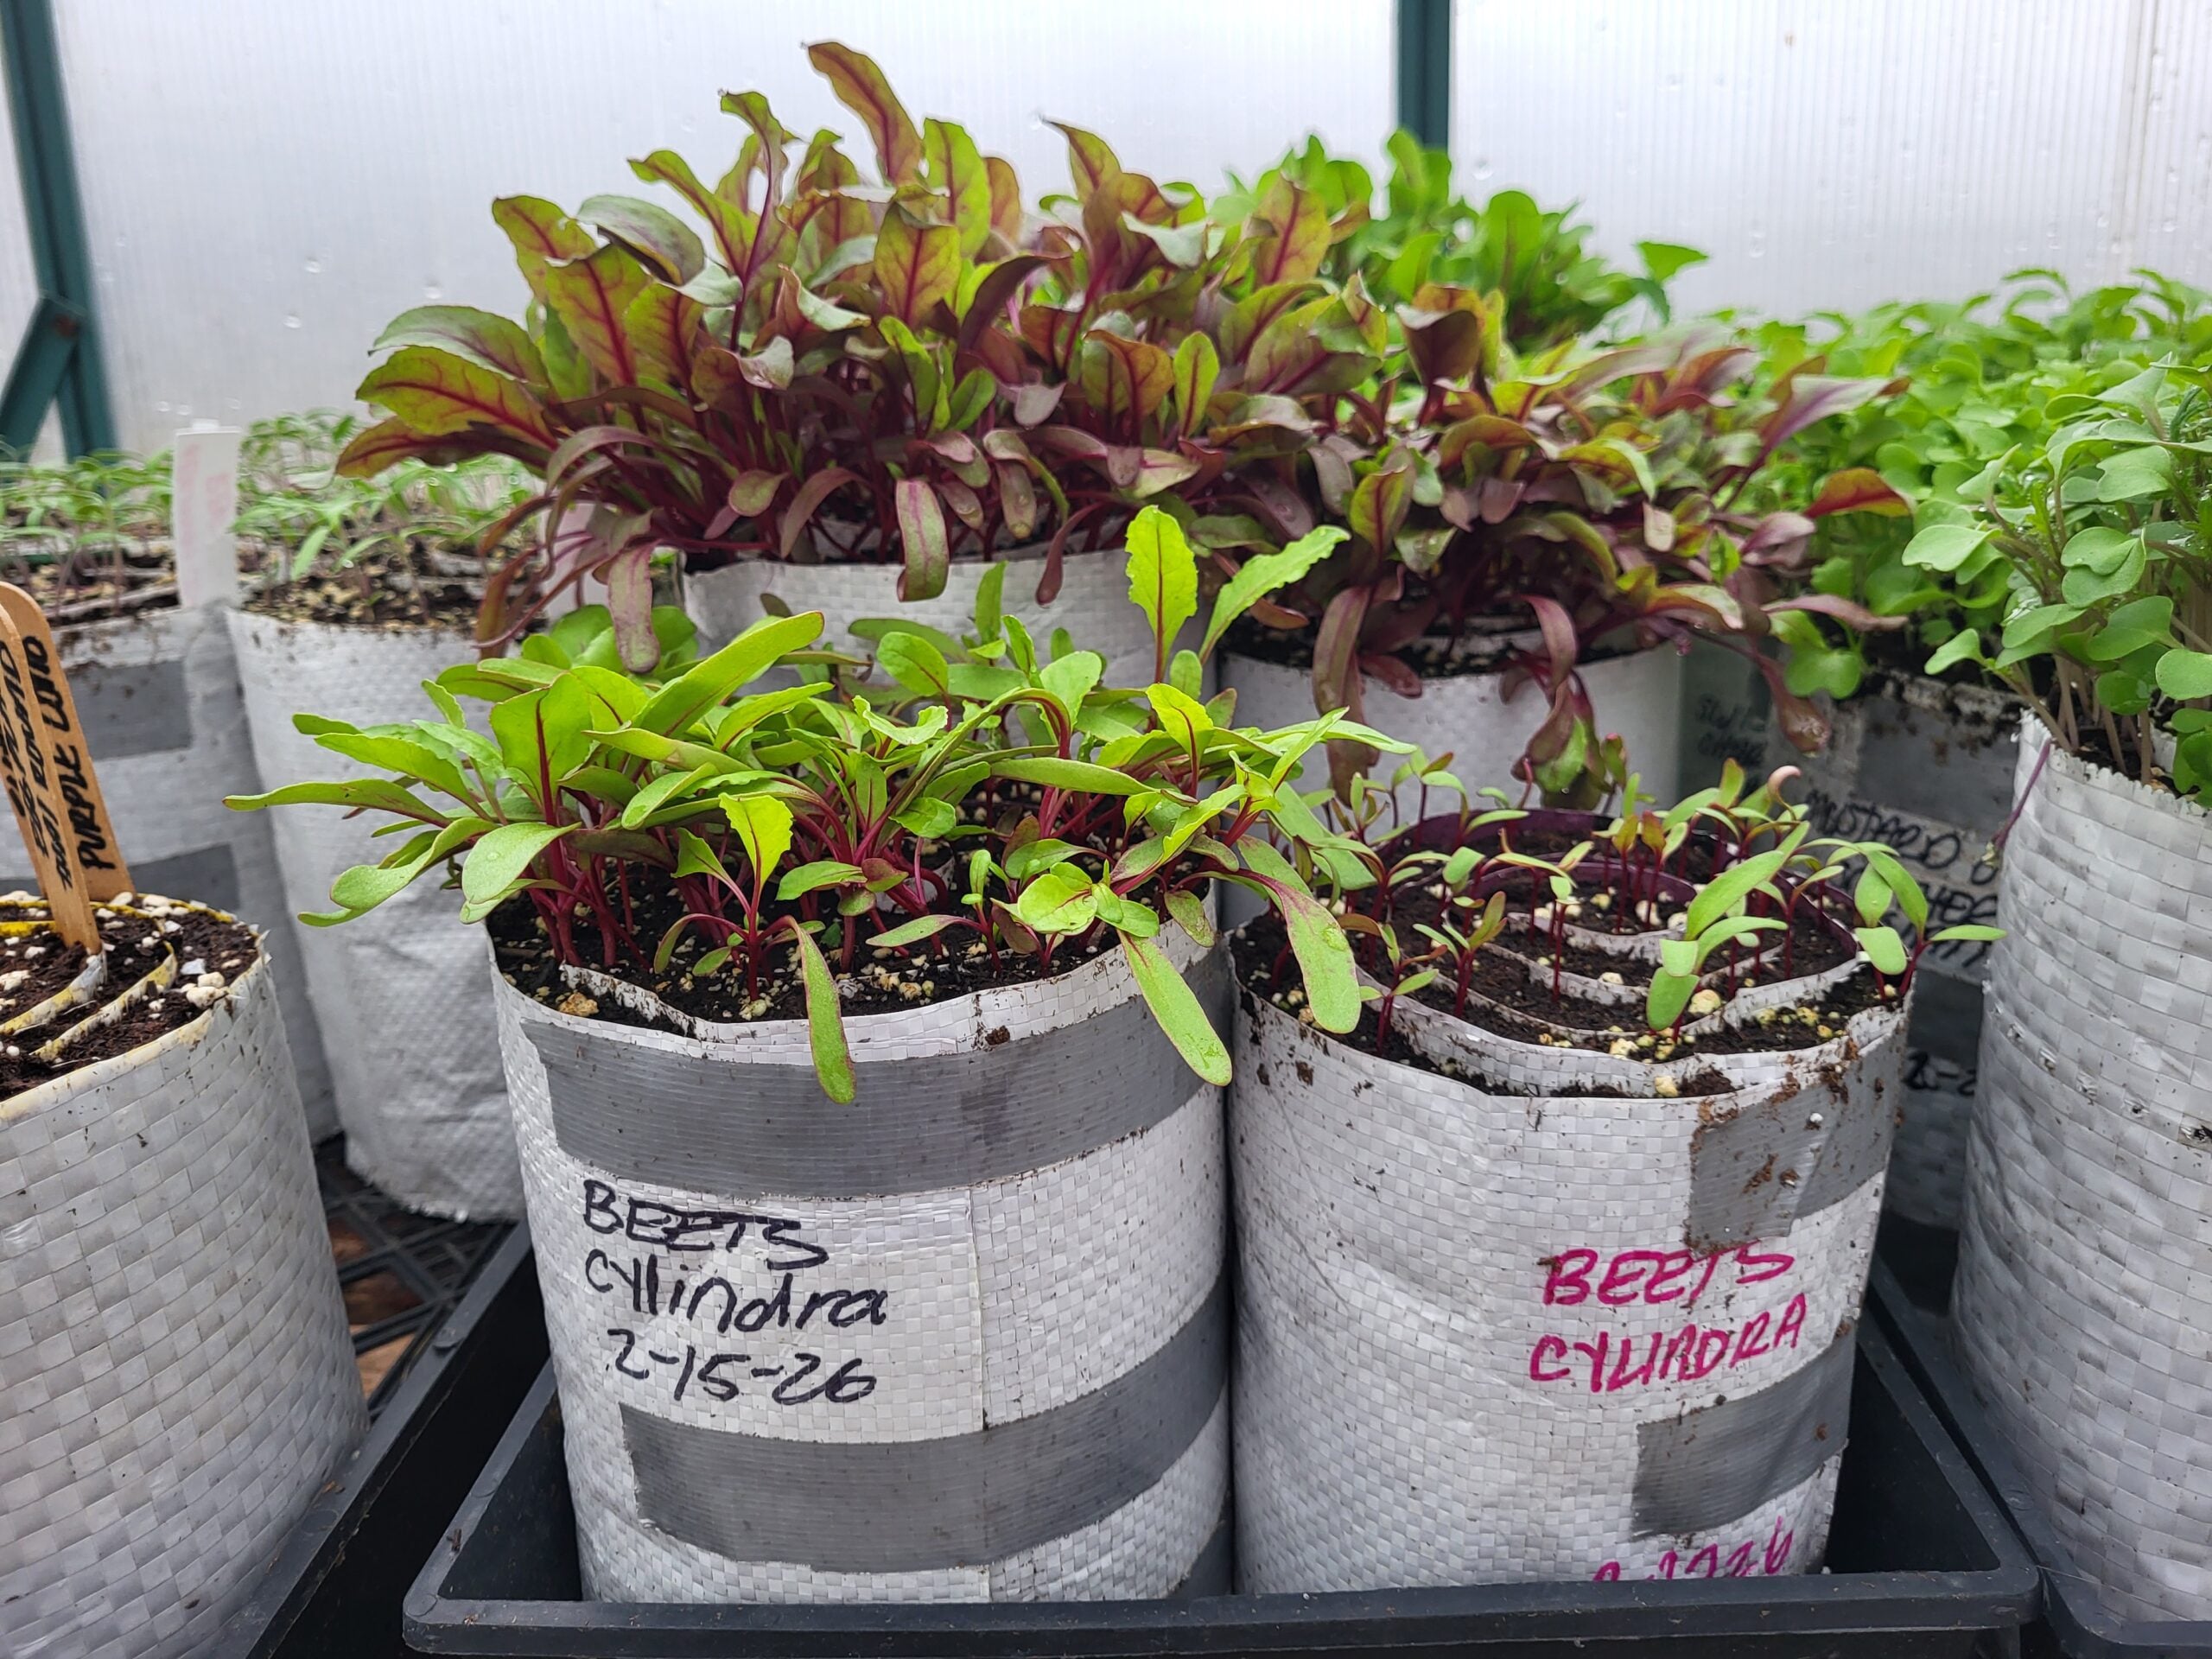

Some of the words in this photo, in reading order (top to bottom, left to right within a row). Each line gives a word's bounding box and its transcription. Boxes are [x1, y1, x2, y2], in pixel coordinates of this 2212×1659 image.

[54, 744, 116, 869] PURPLE
[583, 1179, 829, 1270] BEETS
[1543, 1240, 1796, 1305] BEETS
[607, 1328, 877, 1406] 2-15-26
